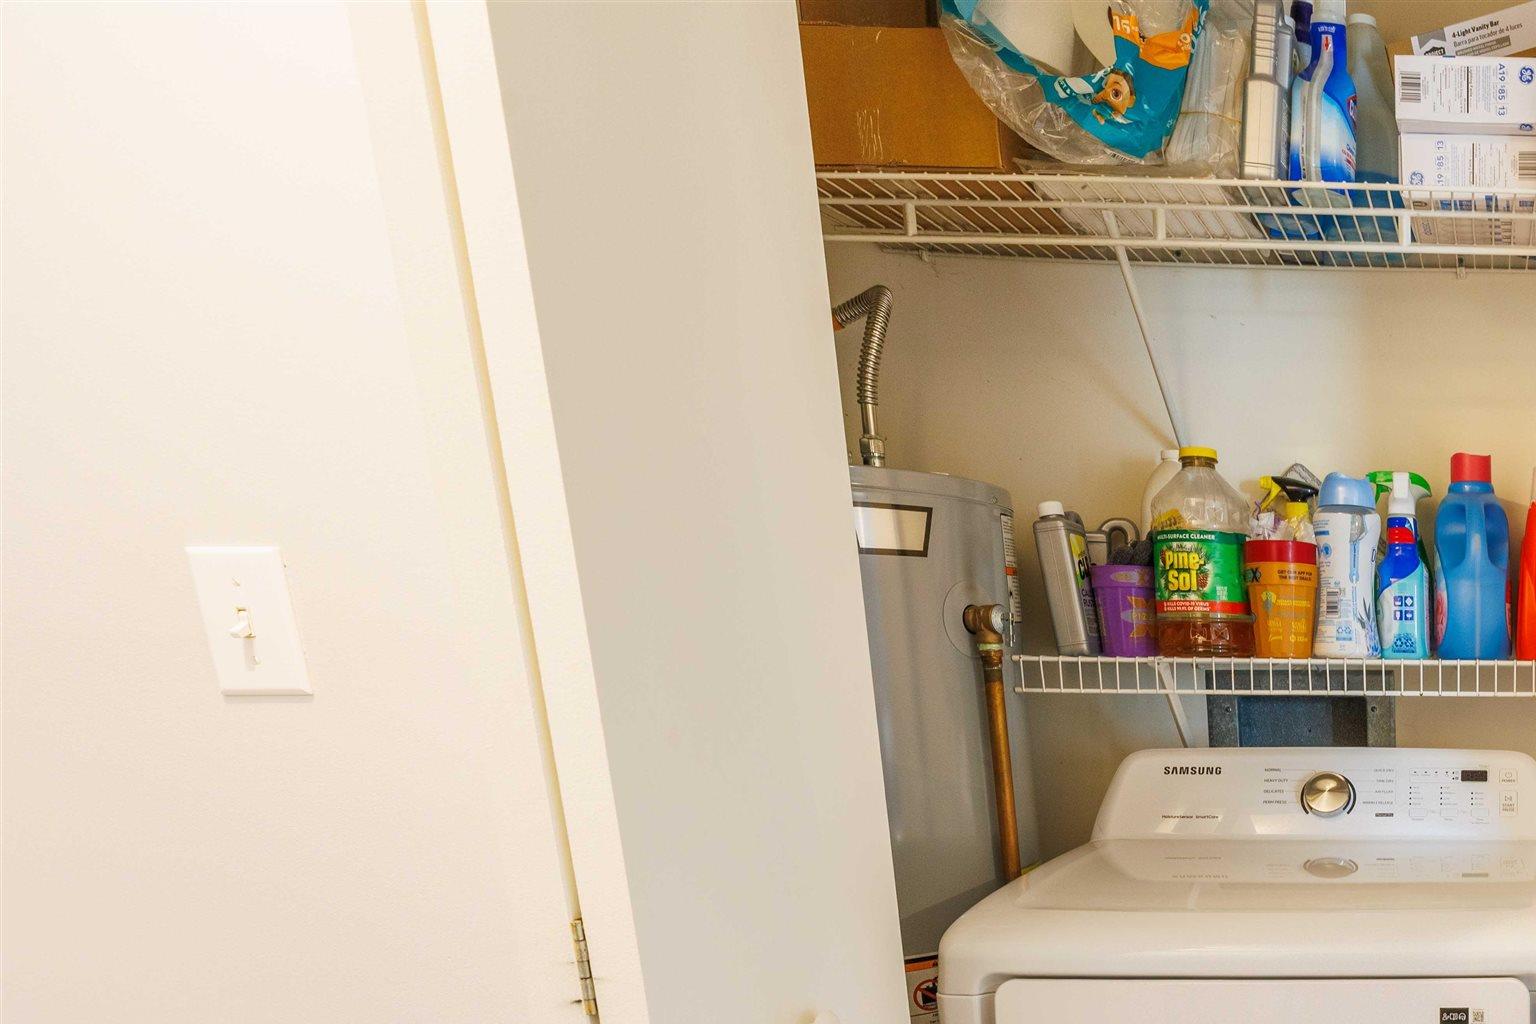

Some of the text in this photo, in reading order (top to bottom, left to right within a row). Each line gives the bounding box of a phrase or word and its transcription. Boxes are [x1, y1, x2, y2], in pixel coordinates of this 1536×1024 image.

[1451, 19, 1500, 39] 4-Light Vanity Bar
[1453, 37, 1468, 48] Barra
[1468, 34, 1480, 46] para
[1479, 29, 1498, 42] tocador
[1509, 22, 1523, 33] luces
[1497, 63, 1508, 82] A19
[1497, 106, 1508, 117] 13
[1437, 140, 1445, 150] 13
[1163, 766, 1222, 776] SAMSUNG
